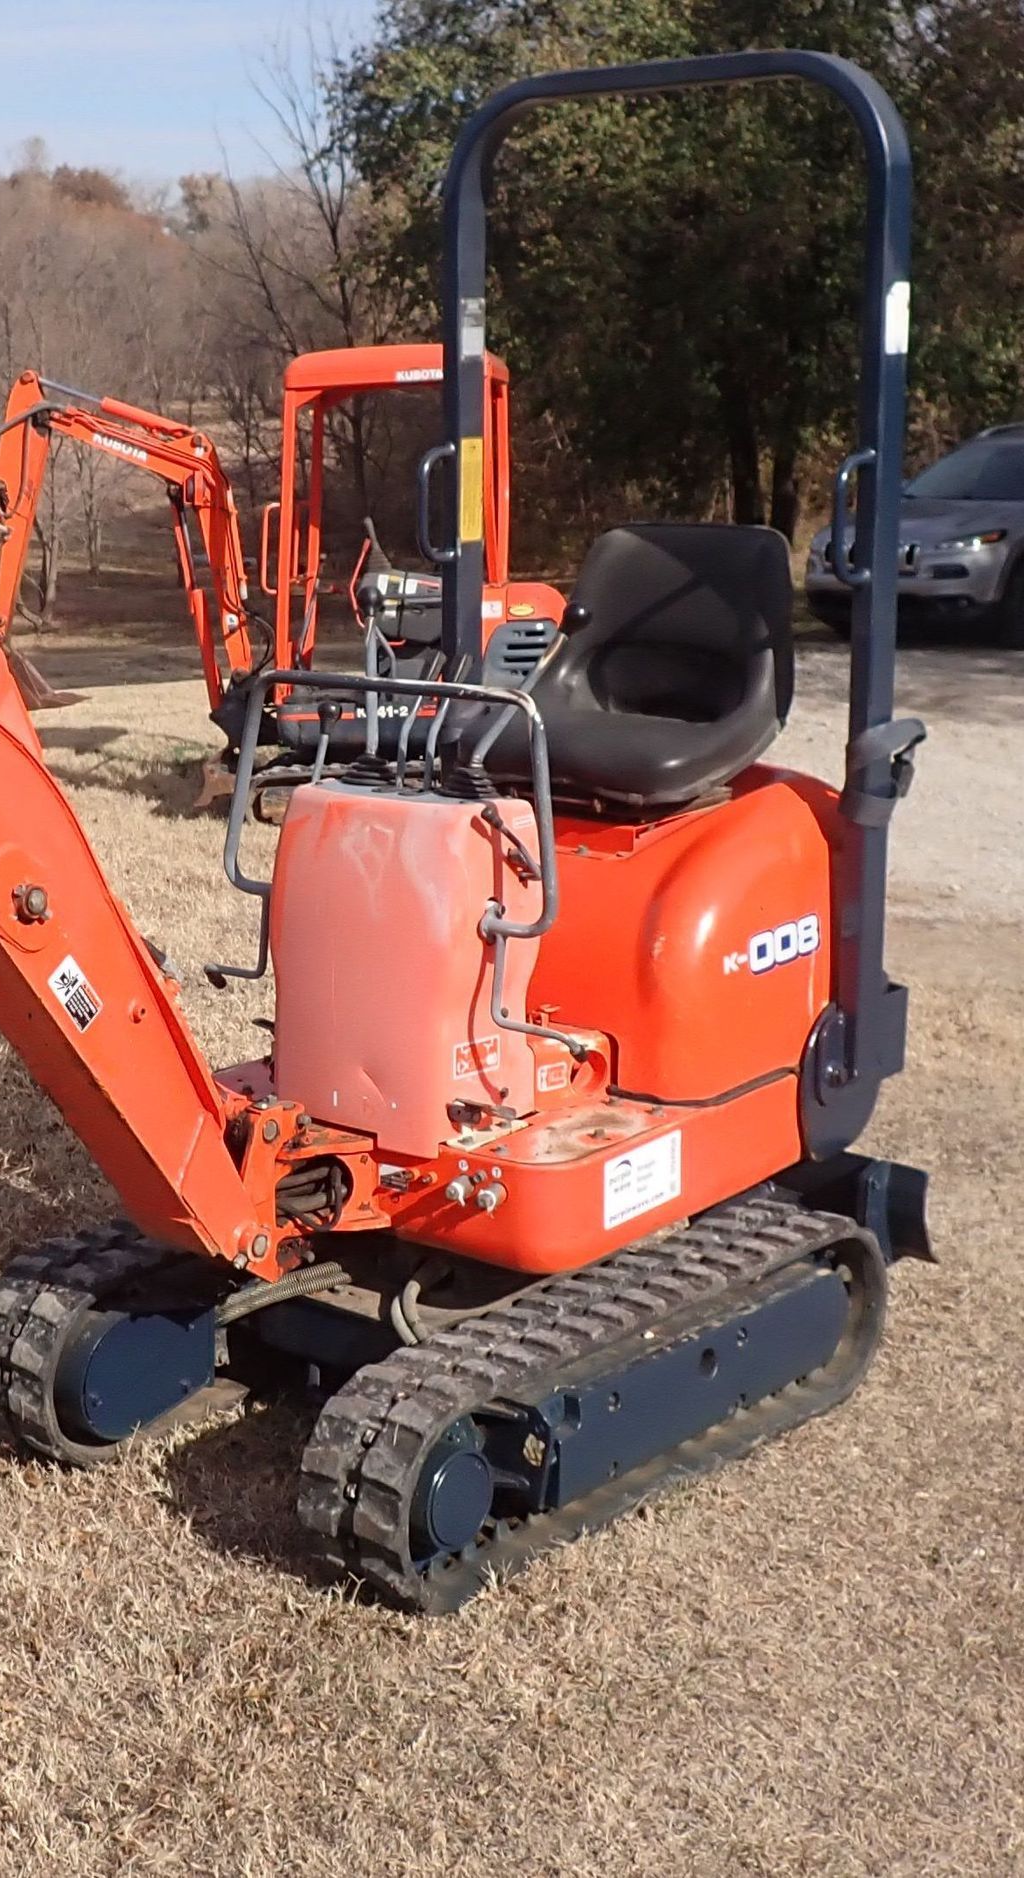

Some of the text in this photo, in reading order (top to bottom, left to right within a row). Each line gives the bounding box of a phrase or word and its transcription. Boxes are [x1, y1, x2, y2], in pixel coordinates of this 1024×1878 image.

[395, 368, 444, 382] KUBOTA
[356, 705, 409, 719] K41-2
[722, 912, 820, 976] K-008
